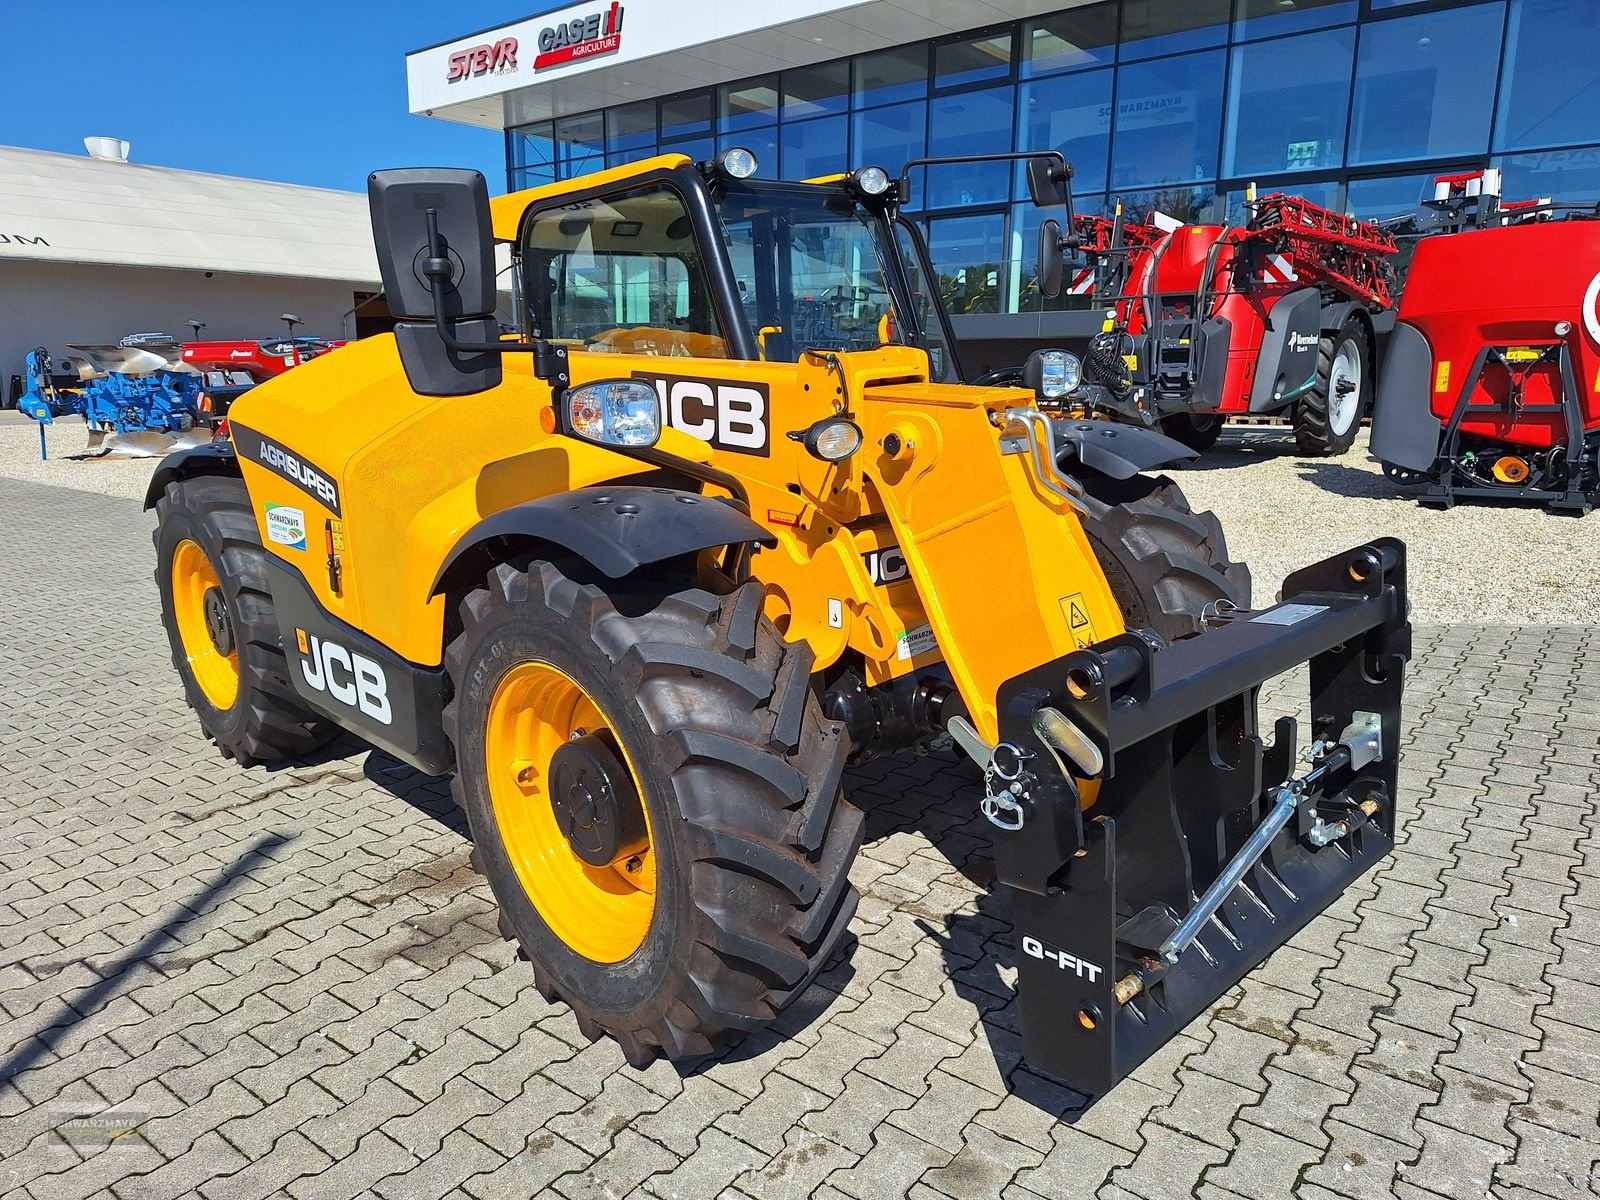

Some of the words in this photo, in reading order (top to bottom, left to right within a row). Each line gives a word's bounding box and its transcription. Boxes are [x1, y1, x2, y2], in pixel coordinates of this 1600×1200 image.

[538, 13, 601, 51] CASE
[572, 37, 617, 57] AGRICULTURE
[446, 37, 519, 81] STEYR
[1098, 96, 1183, 117] SCWARZMAYR
[260, 441, 338, 508] AGRISUPER
[301, 634, 393, 725] JCB
[1023, 936, 1103, 983] Q-FIT
